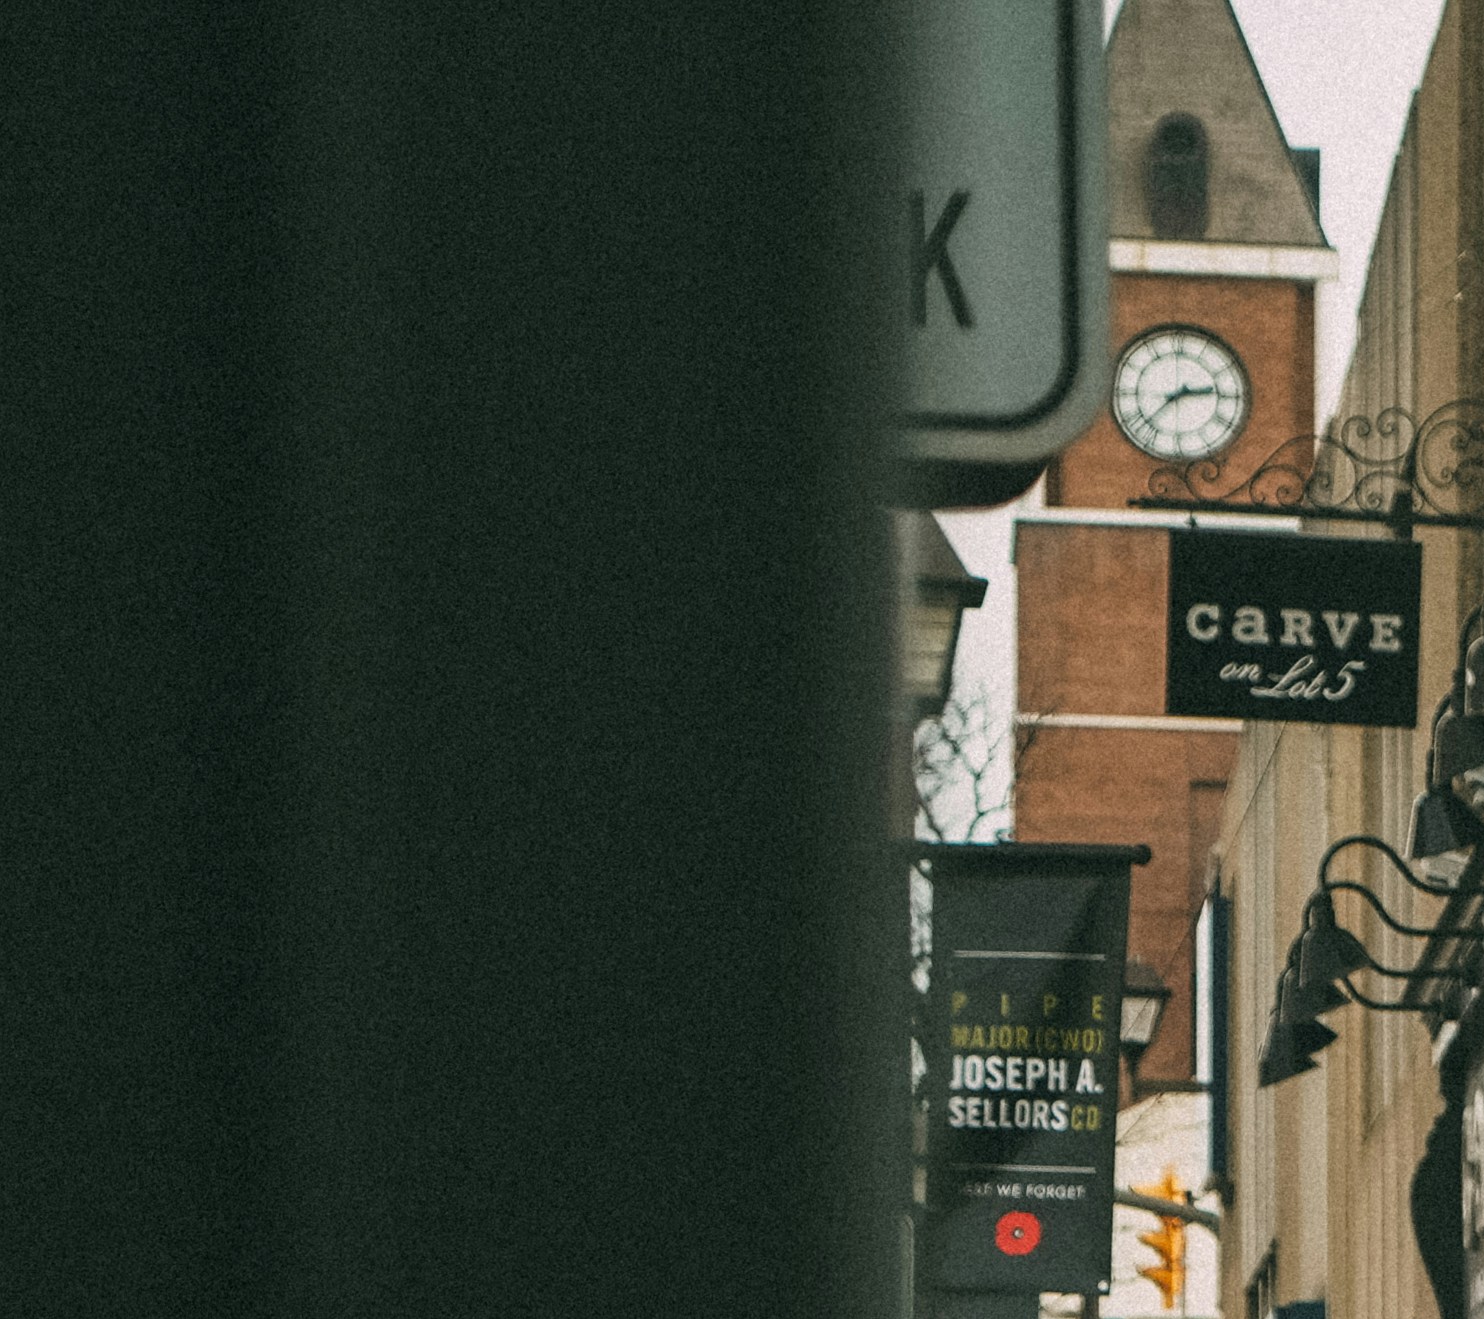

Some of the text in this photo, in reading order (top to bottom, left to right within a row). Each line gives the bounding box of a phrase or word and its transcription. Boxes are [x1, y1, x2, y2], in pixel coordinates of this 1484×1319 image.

[1219, 654, 1367, 700] on Lot 5
[951, 1025, 1030, 1050] MAJOR
[949, 1054, 1105, 1094] JOSEPH A.
[949, 1096, 1070, 1132] SELLORS
[996, 1182, 1021, 1198] WE
